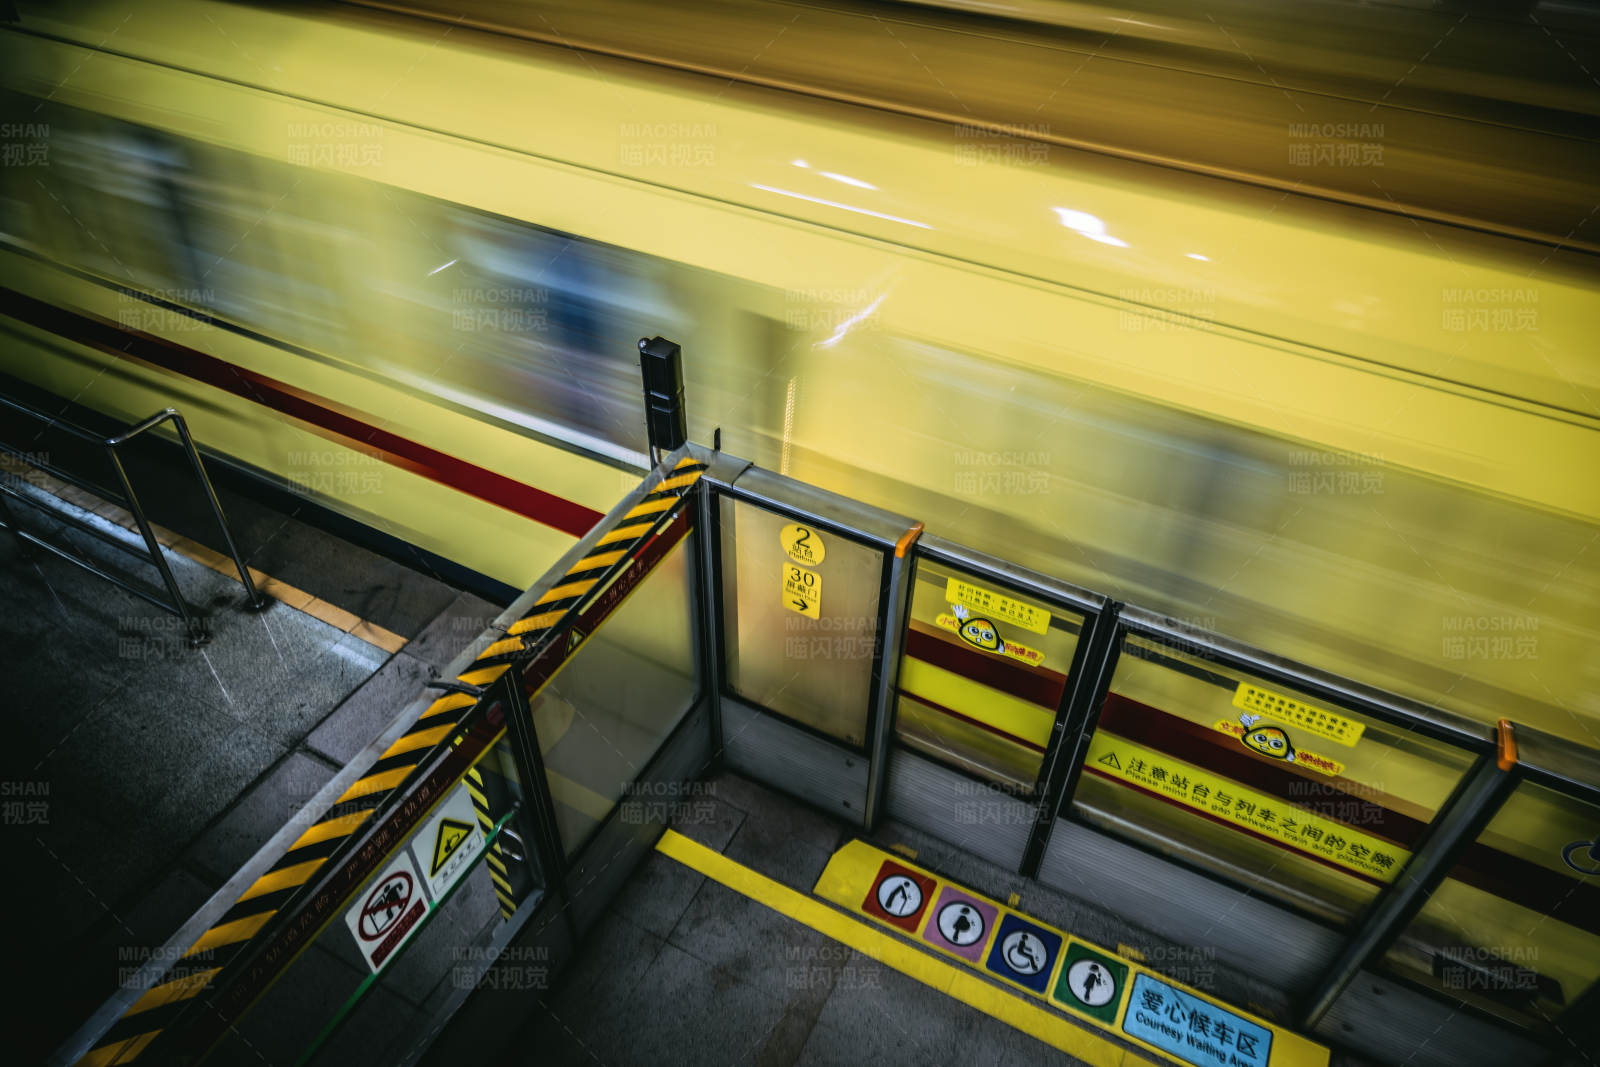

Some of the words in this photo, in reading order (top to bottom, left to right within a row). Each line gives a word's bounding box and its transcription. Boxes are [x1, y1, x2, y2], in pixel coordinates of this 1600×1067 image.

[796, 527, 810, 549] 2
[791, 567, 815, 587] 30
[1125, 768, 1159, 789] Please
[1163, 784, 1187, 799] mind
[1191, 795, 1207, 806] the
[1211, 803, 1231, 816] gap
[1235, 811, 1279, 835] between
[1283, 830, 1307, 846] train
[1312, 841, 1332, 855] and
[1336, 851, 1384, 875] platform
[1127, 757, 1397, 870] 注意站台与列车之间的空隙
[1136, 1011, 1183, 1043] Courtesy
[1186, 1033, 1227, 1064] Waiting
[1141, 990, 1259, 1059] 爱心候车区
